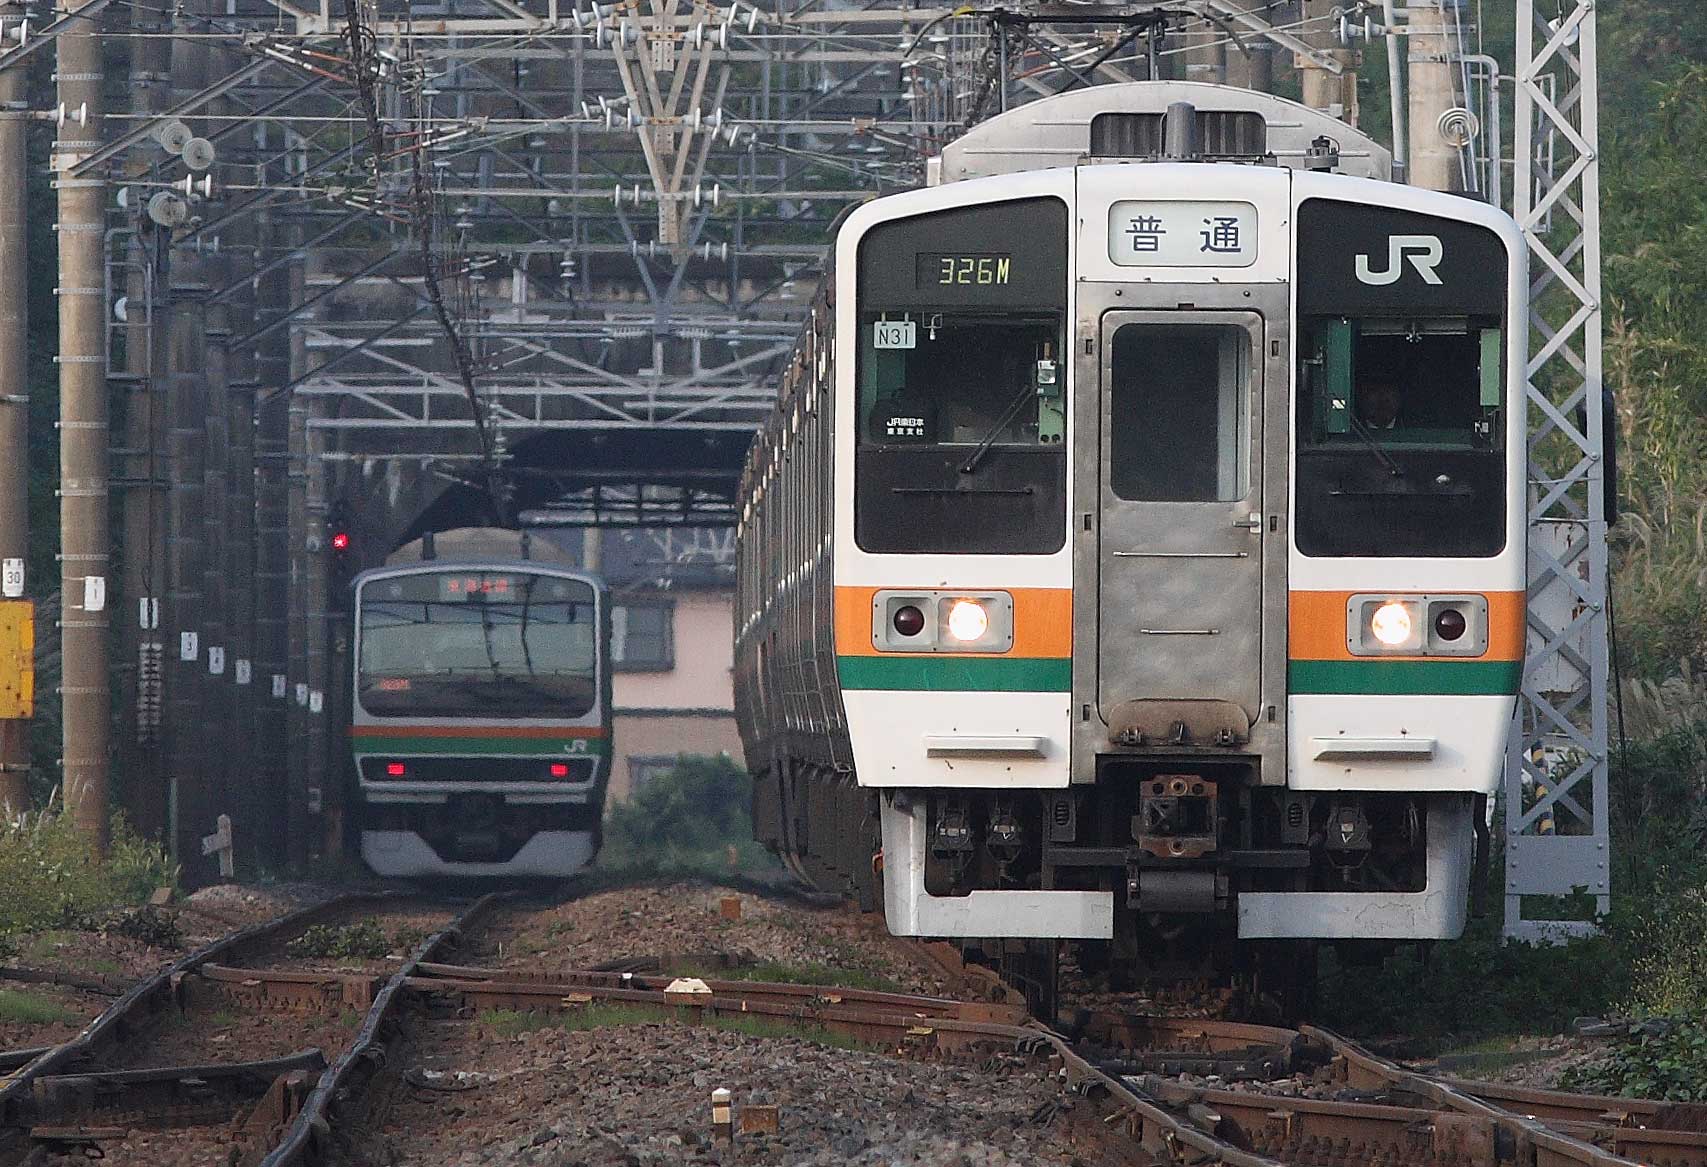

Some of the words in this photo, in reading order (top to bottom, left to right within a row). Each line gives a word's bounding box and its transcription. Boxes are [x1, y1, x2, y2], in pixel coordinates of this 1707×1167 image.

[1125, 215, 1242, 253] 普通
[1355, 235, 1443, 285] JR
[939, 258, 1010, 284] 326M
[879, 328, 909, 345] N31
[7, 571, 21, 584] 30
[563, 739, 587, 753] JR
